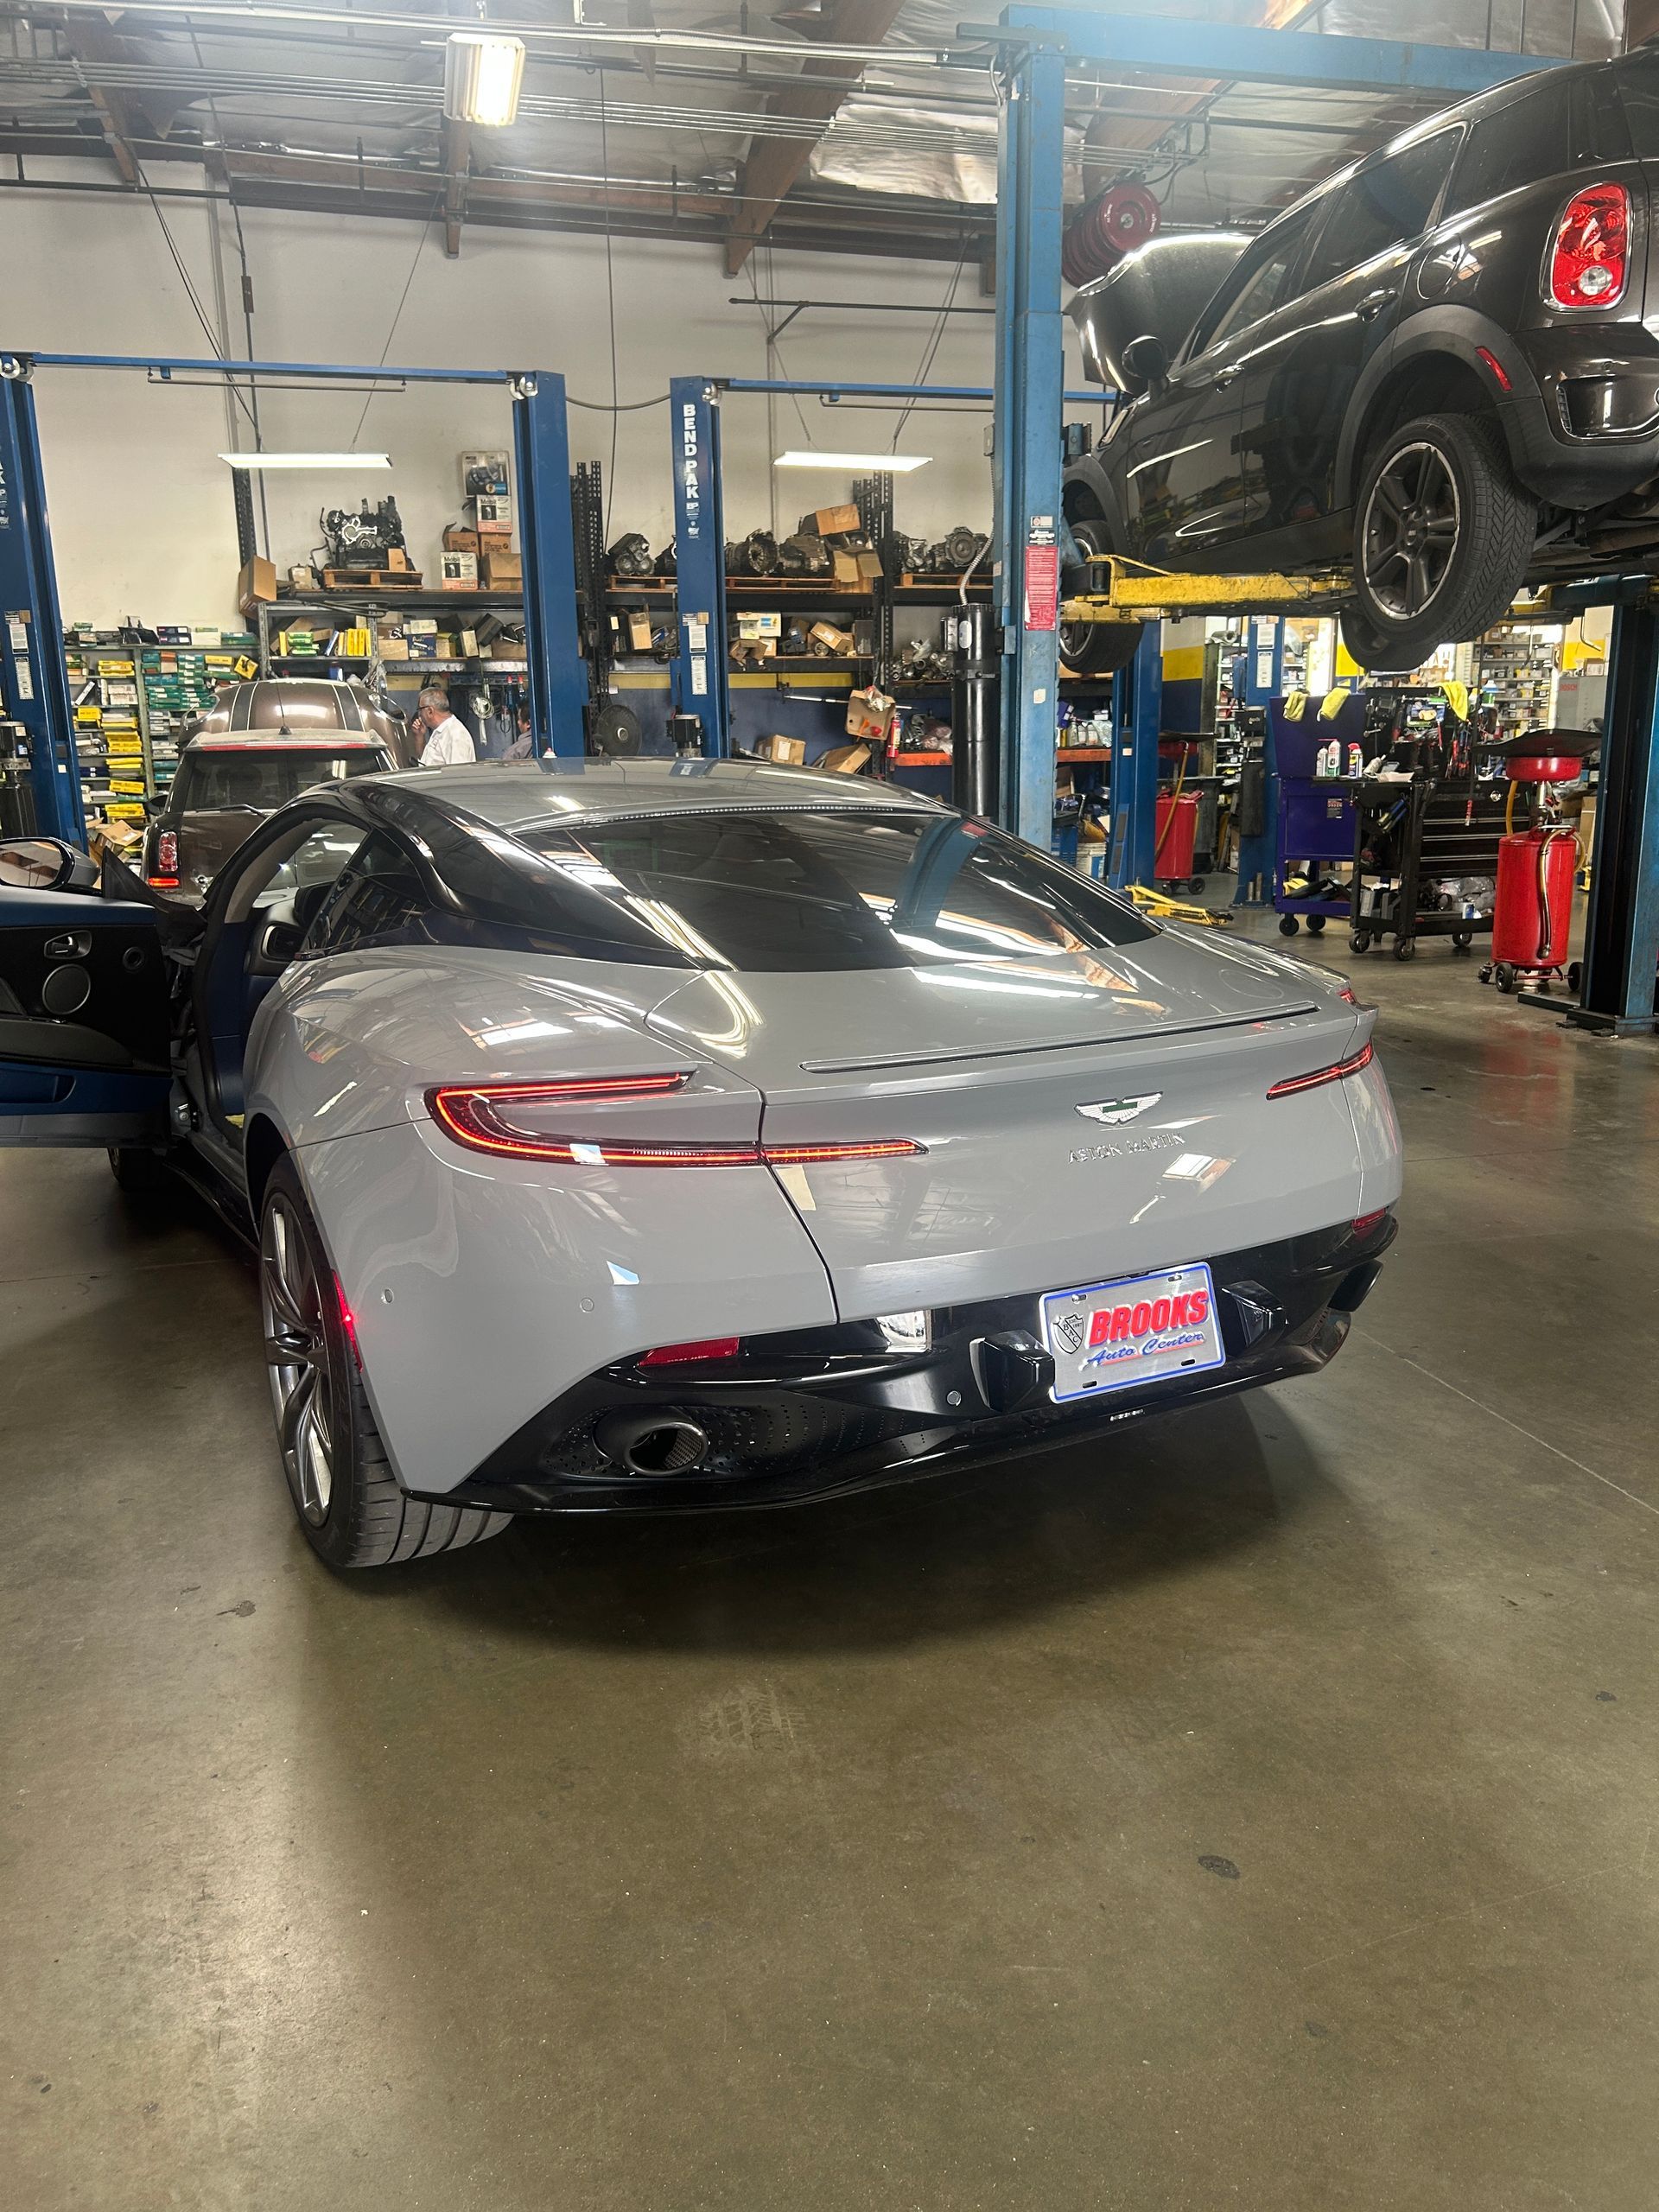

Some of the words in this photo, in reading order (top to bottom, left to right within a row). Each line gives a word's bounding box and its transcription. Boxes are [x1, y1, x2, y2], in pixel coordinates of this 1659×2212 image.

[1068, 1142, 1123, 1164] ASTON
[1126, 1132, 1186, 1154] MARTIN
[1087, 1288, 1210, 1347] BROOKS
[1086, 1348, 1136, 1365] Auto
[1141, 1332, 1205, 1356] Center
